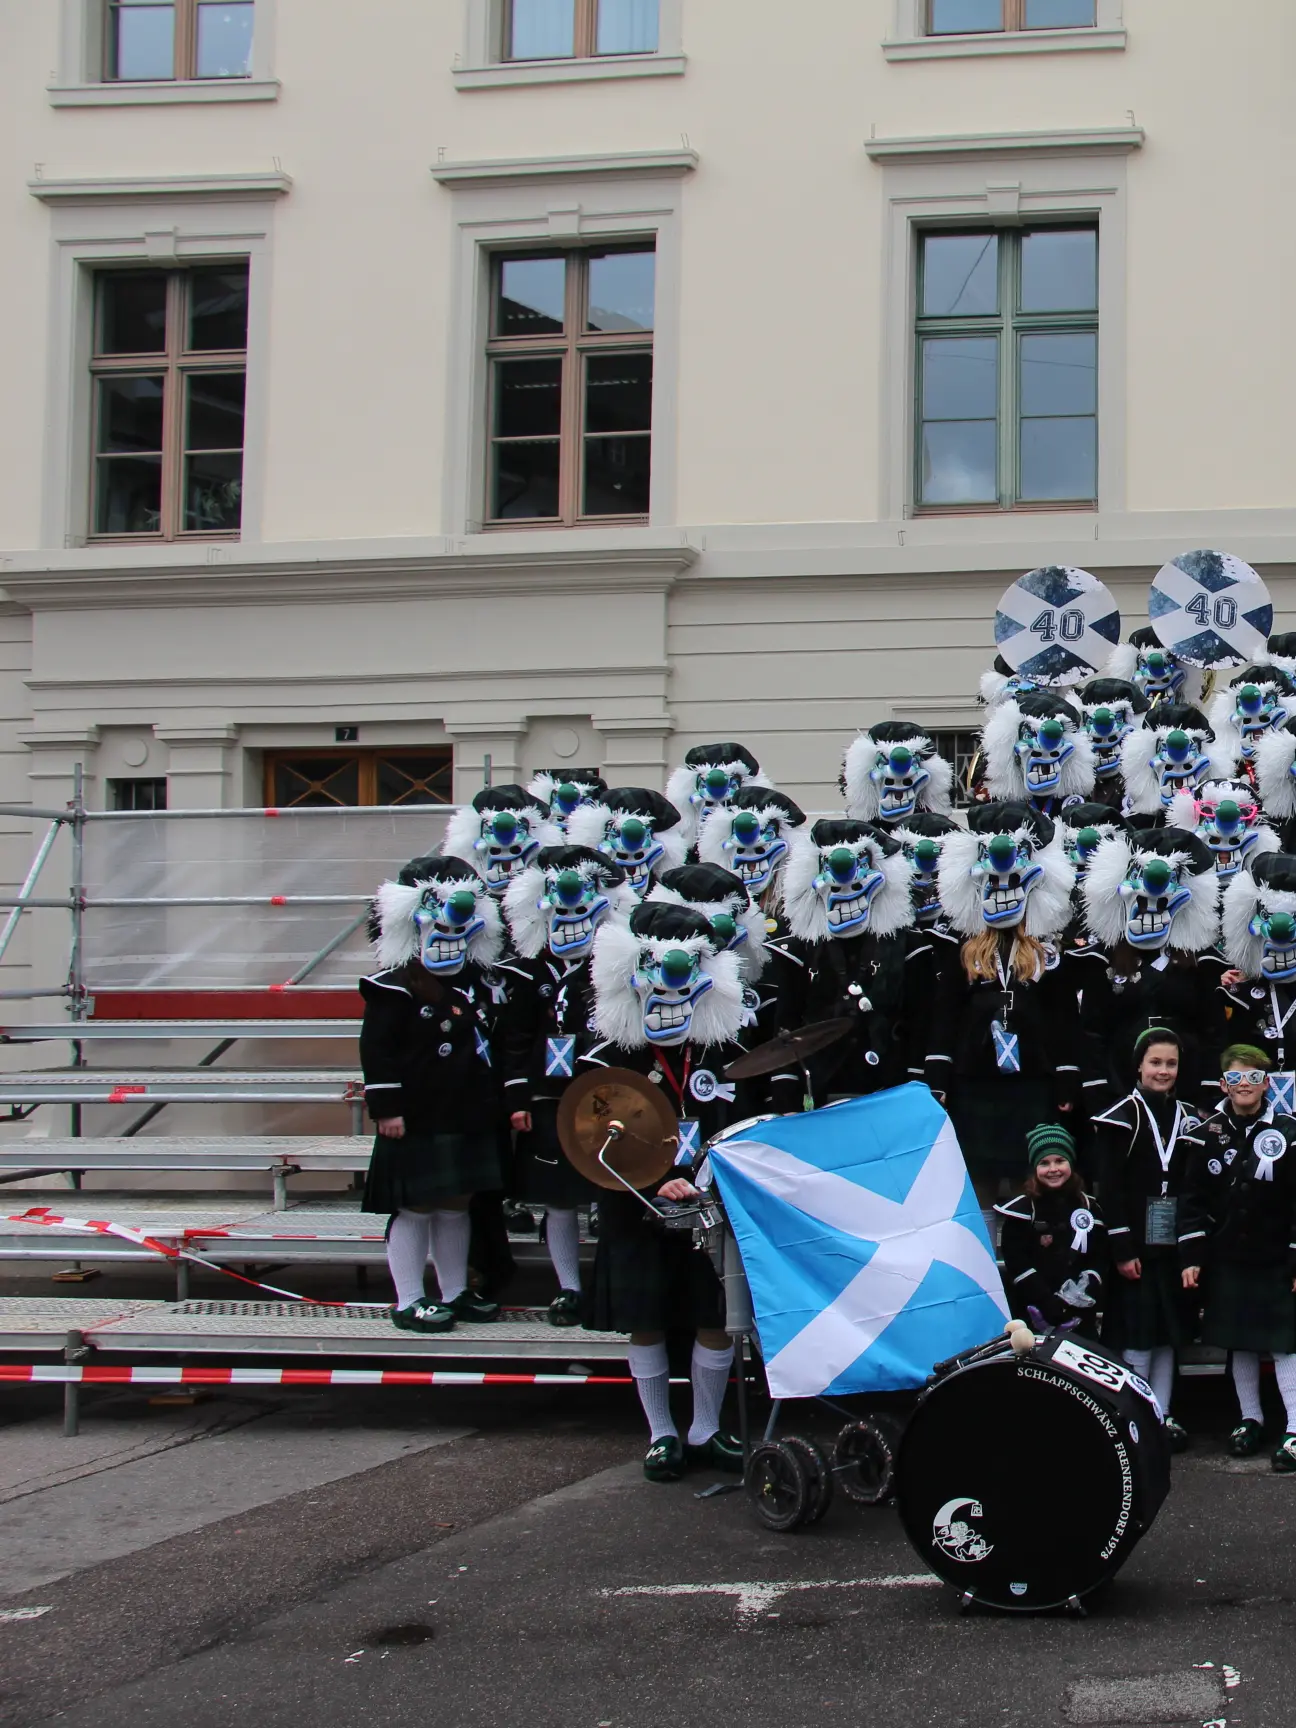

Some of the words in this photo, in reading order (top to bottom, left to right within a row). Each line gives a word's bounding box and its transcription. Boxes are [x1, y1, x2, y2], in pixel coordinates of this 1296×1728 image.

[1029, 608, 1086, 642] 40
[1184, 591, 1238, 630] 40
[342, 728, 350, 740] 7
[415, 1305, 438, 1319] 40
[1017, 1366, 1118, 1438] SCHLAPPSCHWÄNZ
[1113, 1441, 1133, 1536] FRENKENDORF
[1100, 1535, 1120, 1560] 1978
